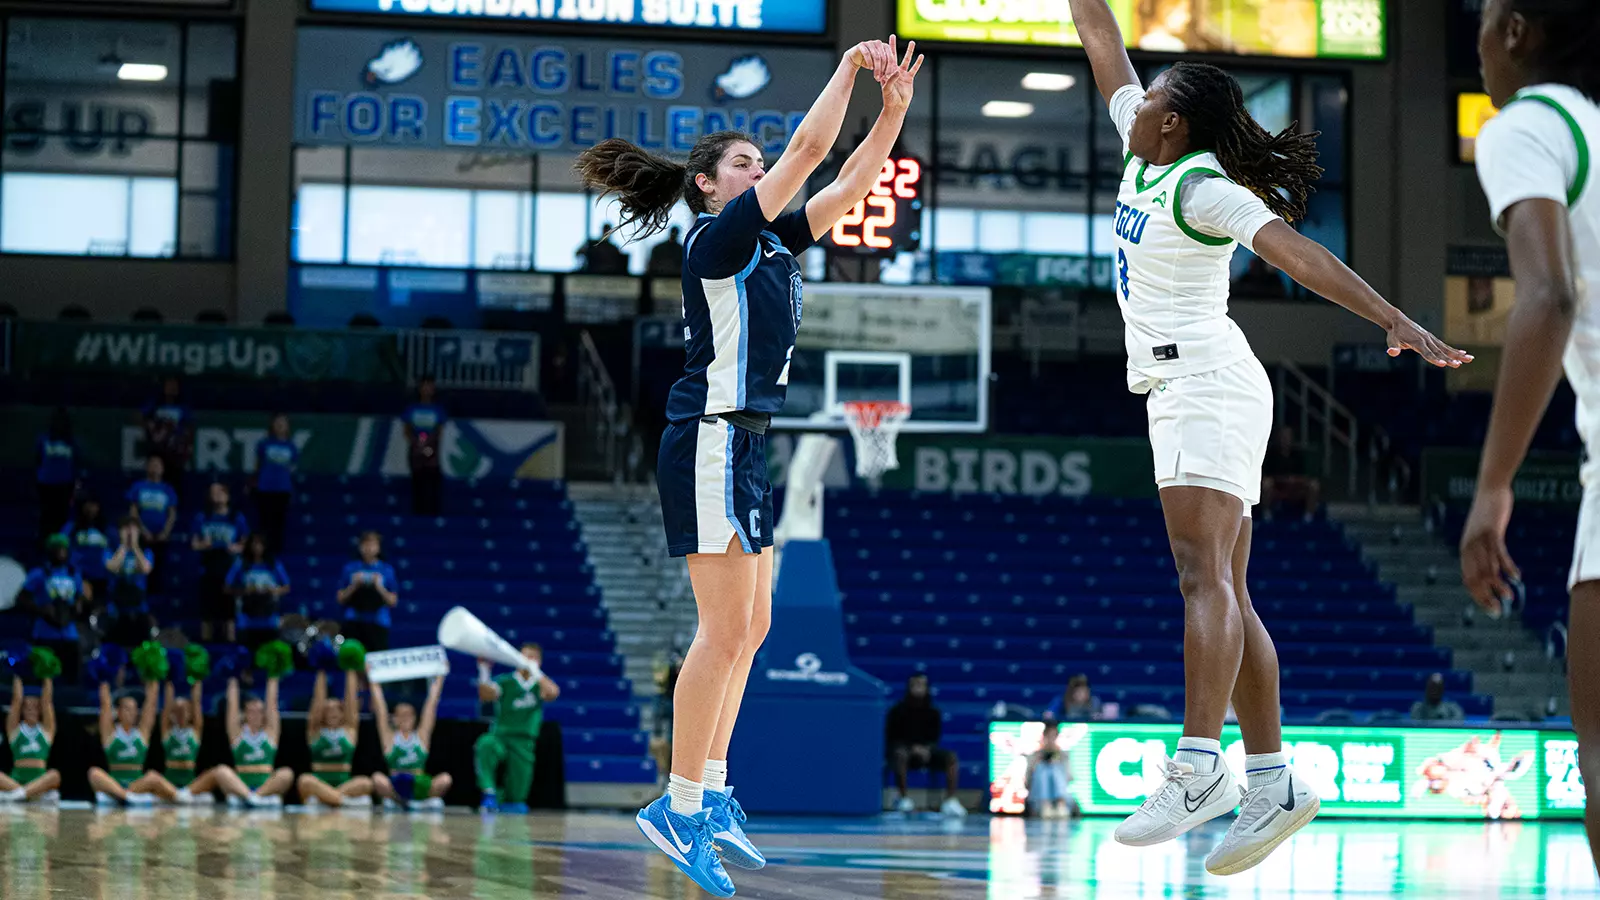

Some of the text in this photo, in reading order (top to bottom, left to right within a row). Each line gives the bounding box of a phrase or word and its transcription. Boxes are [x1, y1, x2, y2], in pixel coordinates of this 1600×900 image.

[449, 44, 684, 98] EAGLES
[306, 90, 810, 152] FOR EXCELLENC
[74, 333, 281, 374] #WingsUp
[914, 447, 1092, 496] BIRDS
